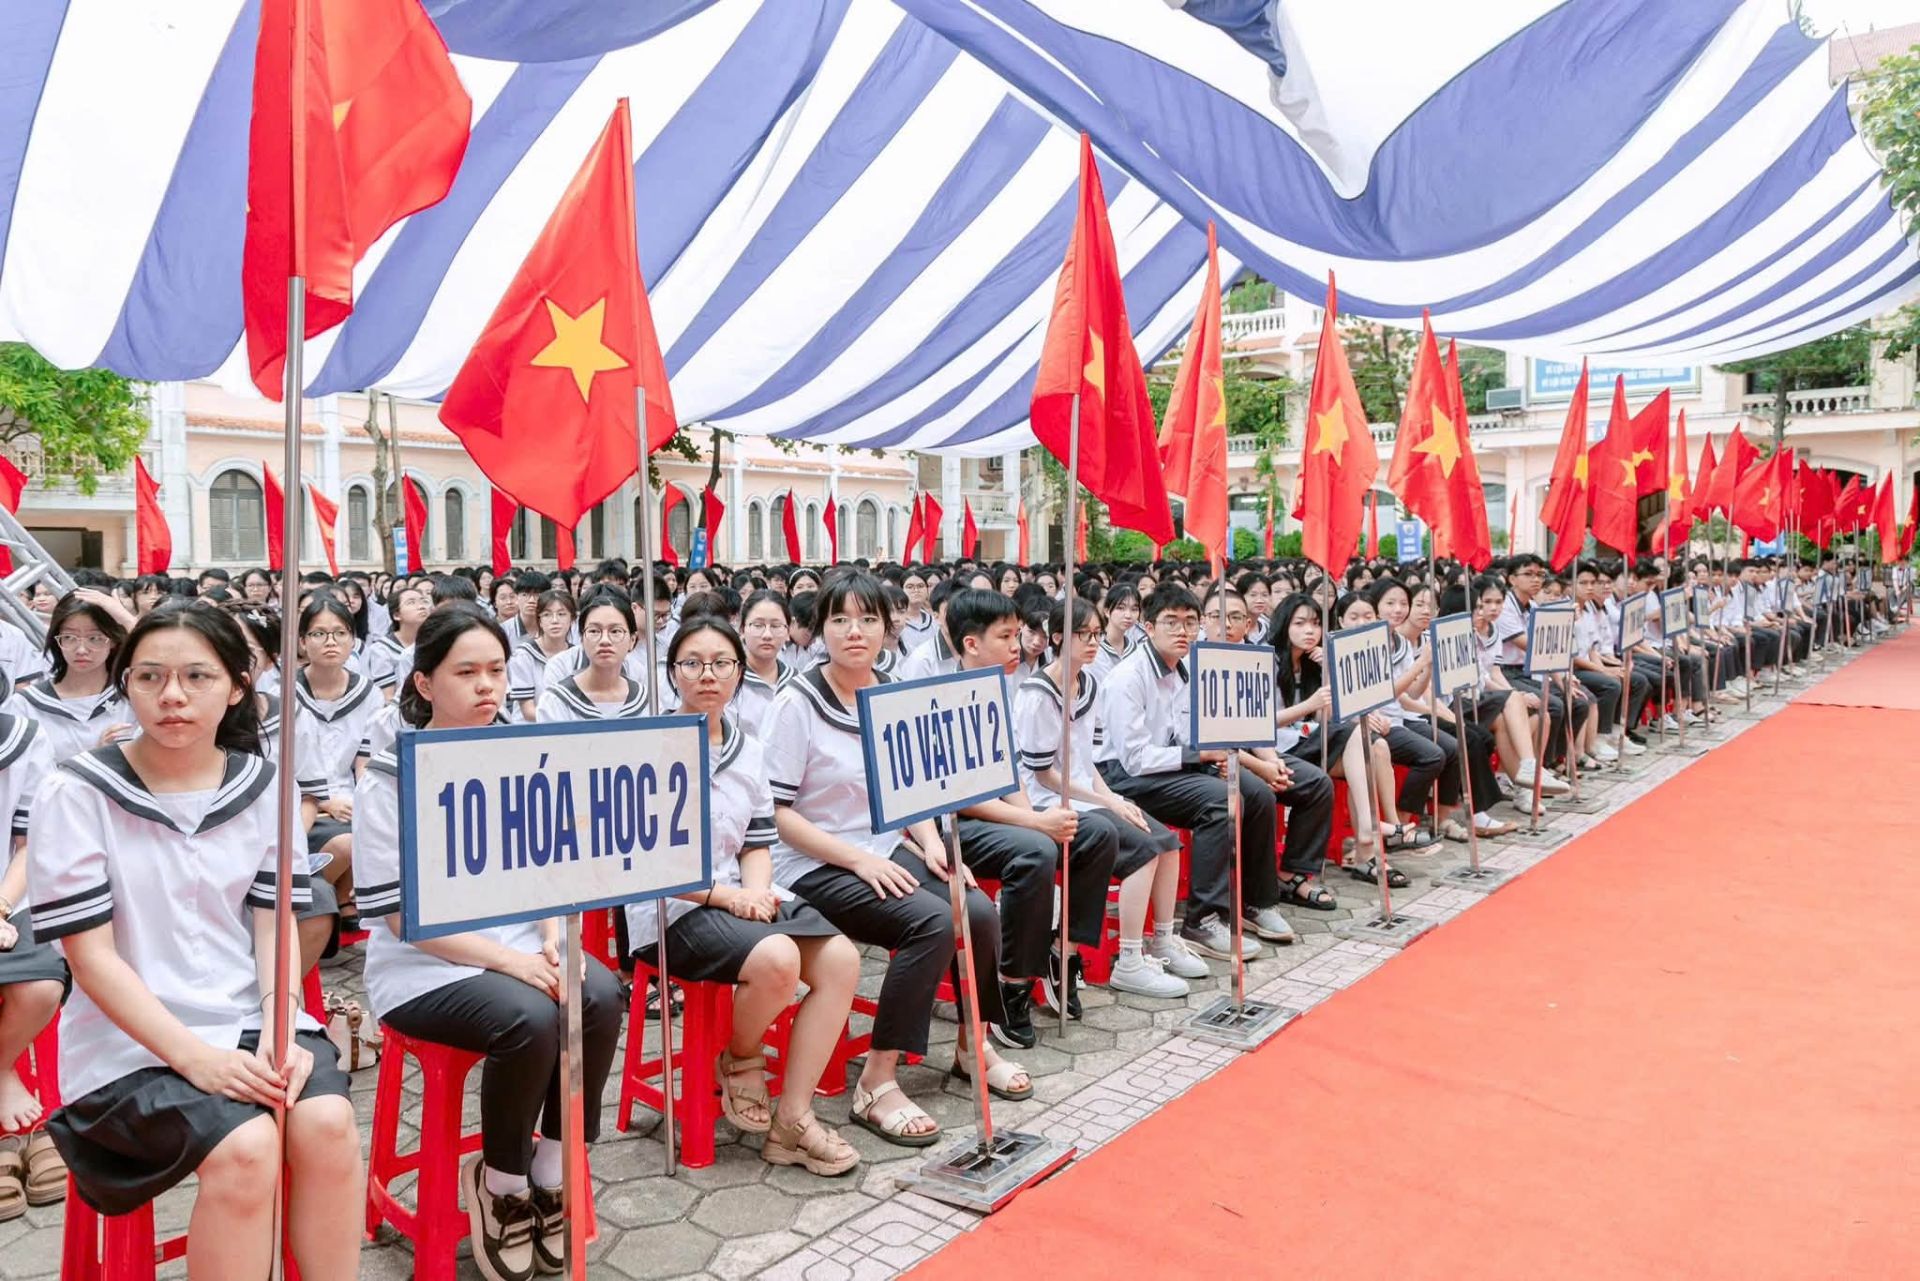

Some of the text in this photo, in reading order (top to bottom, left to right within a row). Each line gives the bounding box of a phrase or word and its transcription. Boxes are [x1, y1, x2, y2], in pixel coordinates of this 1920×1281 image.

[1339, 640, 1390, 696] 10 TOÁN 2
[1438, 637, 1447, 672] 10
[1455, 632, 1470, 668] ANH
[1535, 625, 1545, 655] 10
[1201, 662, 1270, 718] 10 T. PHÁP
[883, 690, 1004, 791] 10 VẬT LÝ 2
[438, 753, 689, 878] 10 HÓA HỌC 2
